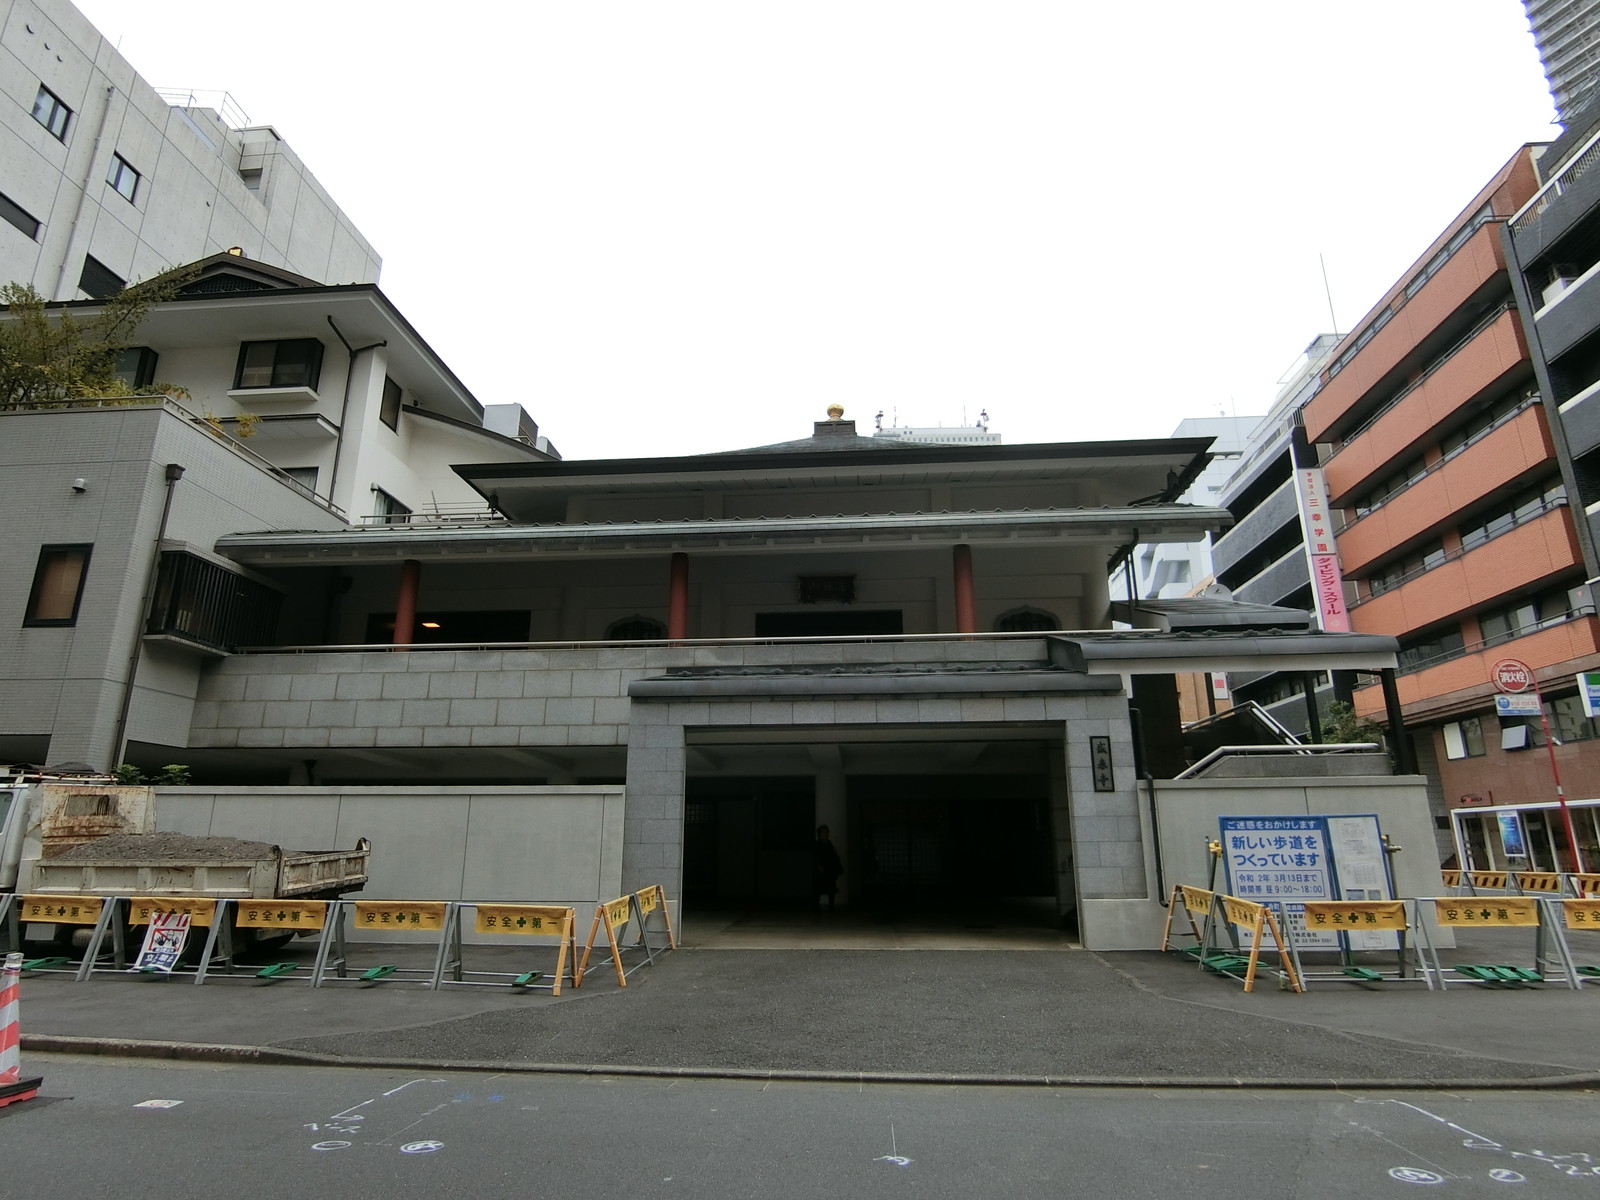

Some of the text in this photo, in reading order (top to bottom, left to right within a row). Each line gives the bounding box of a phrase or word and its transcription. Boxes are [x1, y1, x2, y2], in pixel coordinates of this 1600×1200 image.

[1499, 671, 1527, 683] 消火栓
[1227, 820, 1316, 830] ご迷惑をおかけします
[1231, 835, 1318, 850] 新しい歩道を
[1233, 852, 1320, 867] つくっています
